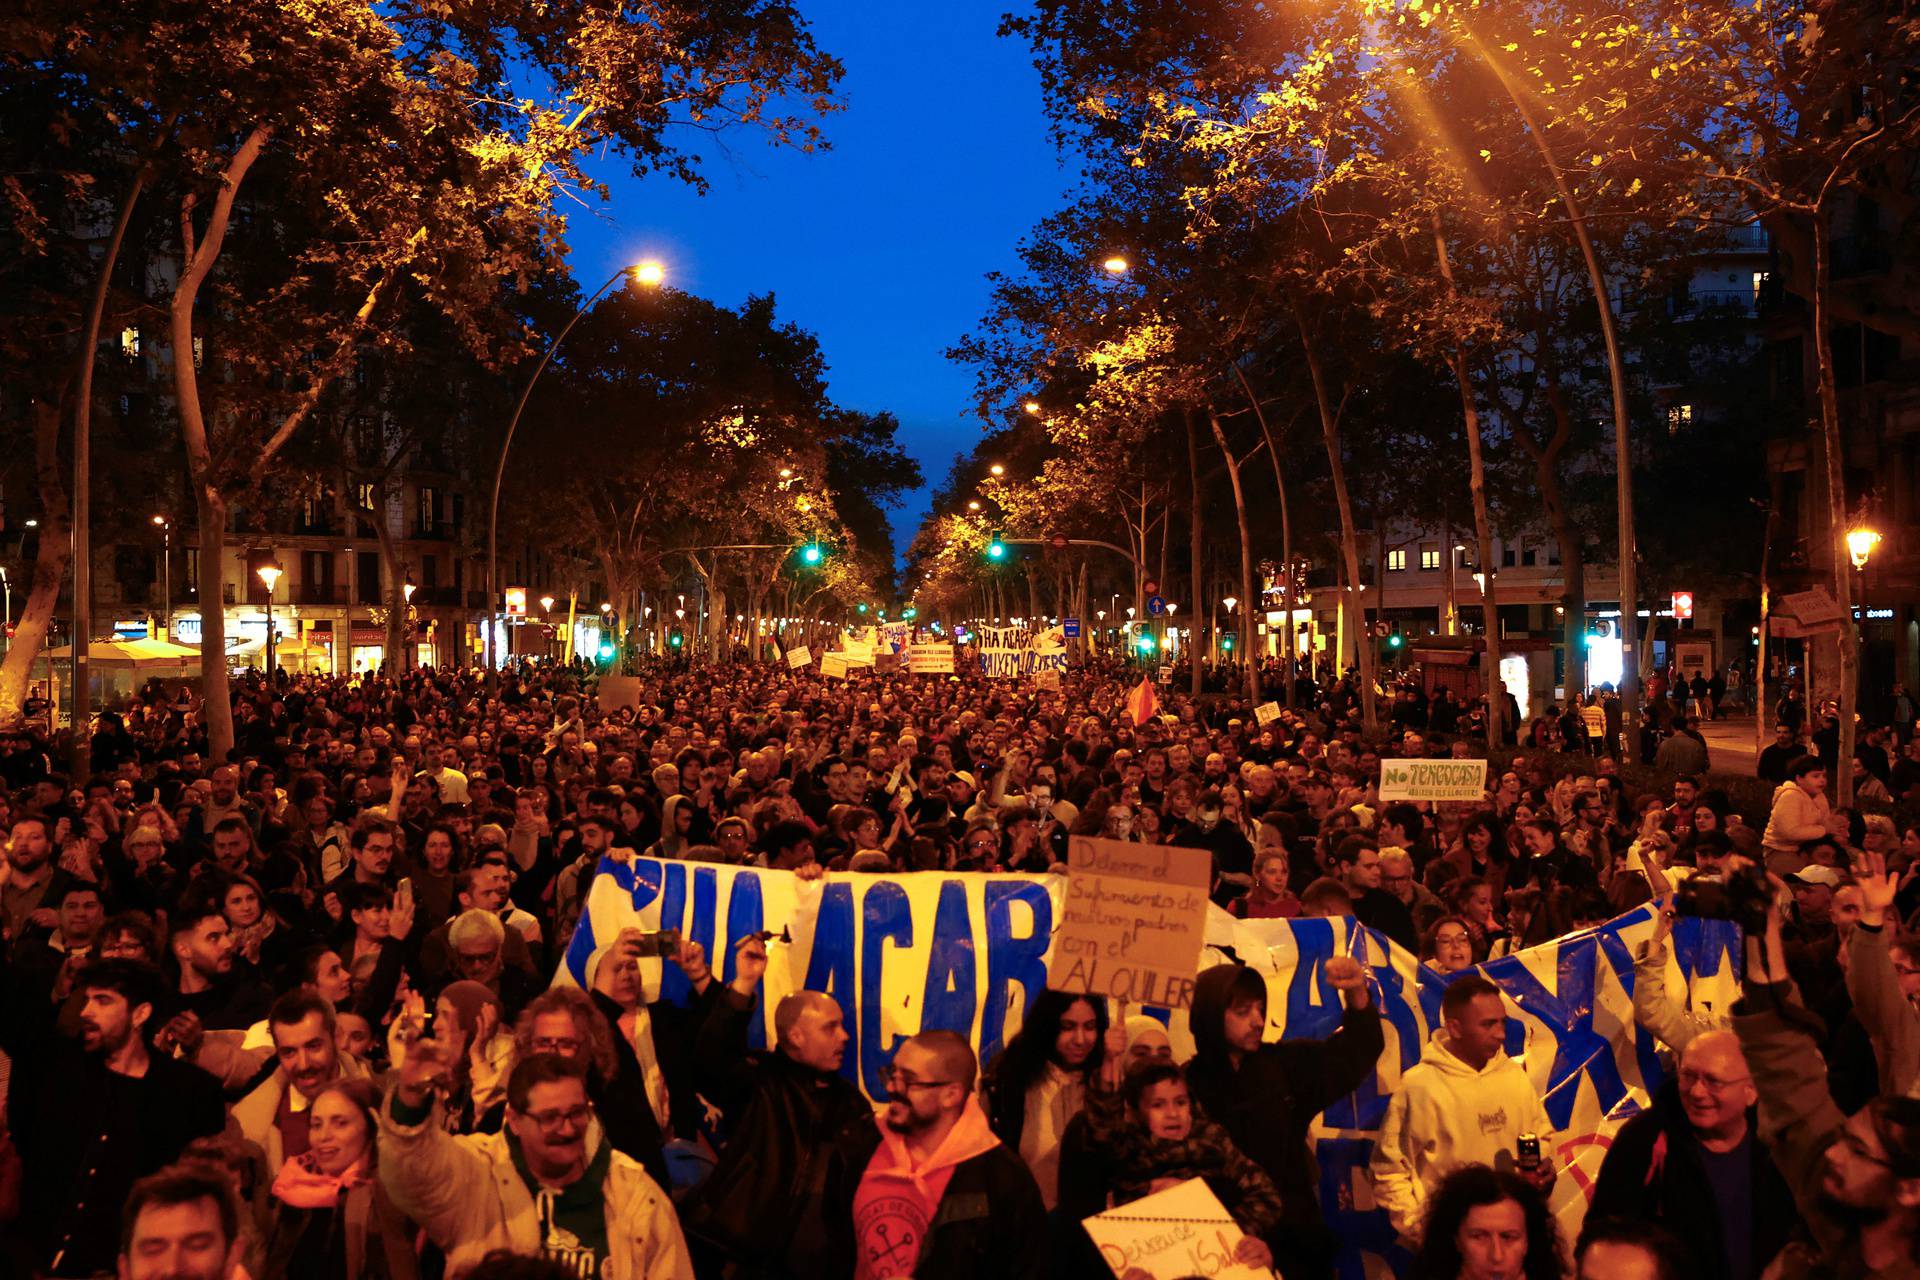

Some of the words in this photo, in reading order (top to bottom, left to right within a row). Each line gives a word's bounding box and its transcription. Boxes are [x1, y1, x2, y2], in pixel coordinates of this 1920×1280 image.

[1385, 768, 1408, 786] No
[1178, 891, 1200, 912] de
[1063, 936, 1098, 956] con
[1107, 931, 1131, 958] el
